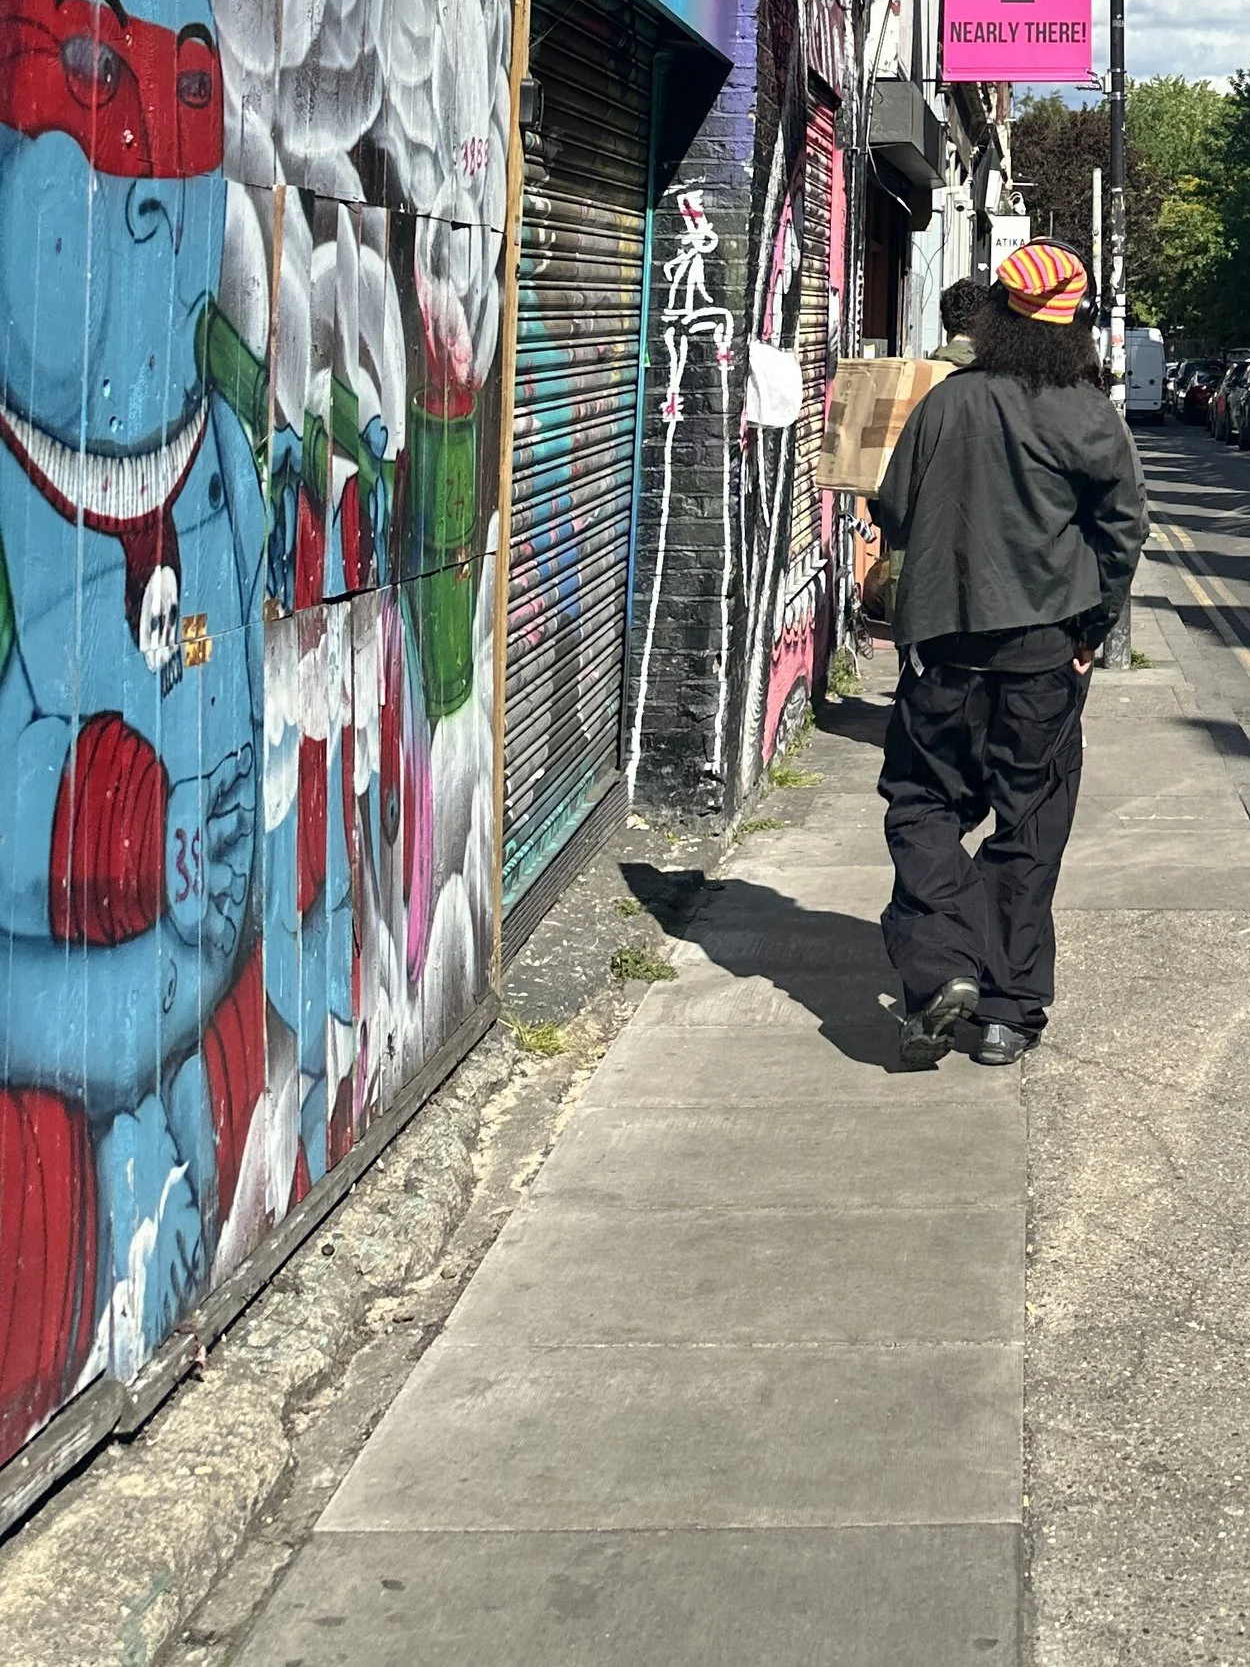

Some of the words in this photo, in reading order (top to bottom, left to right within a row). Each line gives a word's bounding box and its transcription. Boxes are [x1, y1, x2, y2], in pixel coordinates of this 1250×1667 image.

[950, 22, 1020, 43] NEARLY
[1024, 21, 1087, 43] THERE!
[995, 238, 1026, 248] ATIKA
